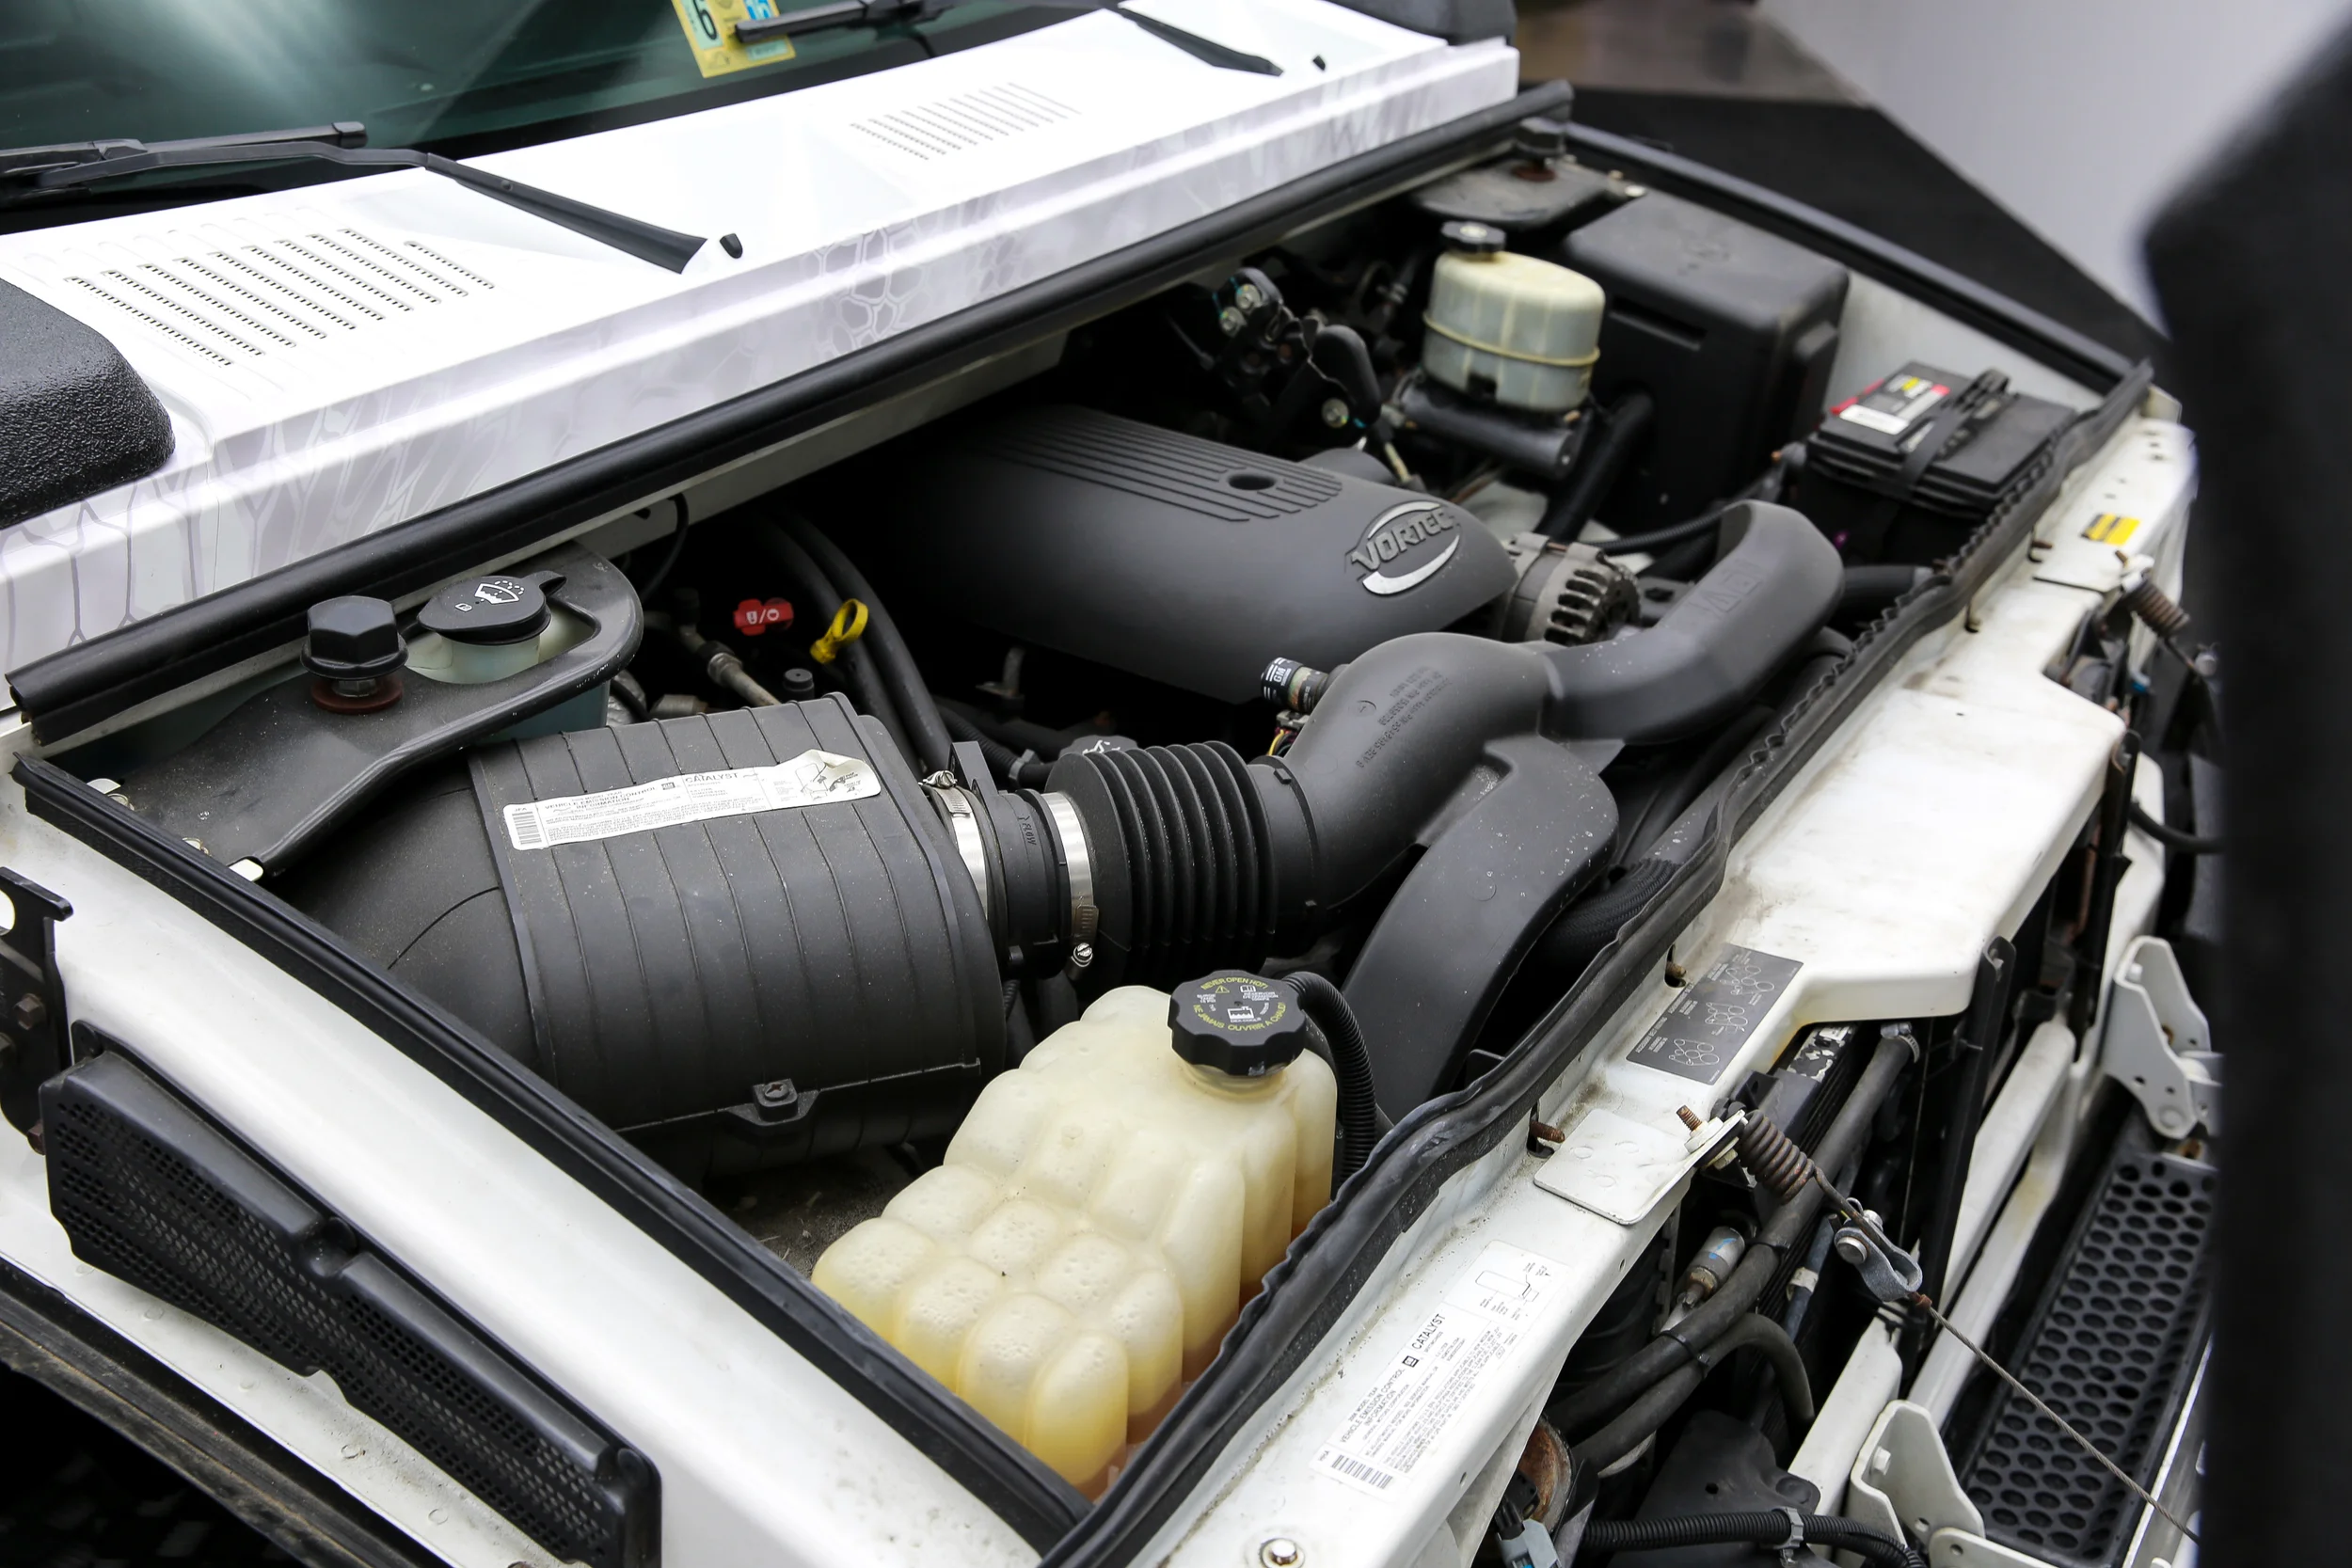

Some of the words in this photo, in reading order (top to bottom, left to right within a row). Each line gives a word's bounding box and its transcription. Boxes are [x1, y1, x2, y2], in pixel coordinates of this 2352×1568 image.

[1351, 507, 1454, 572] VORTEC
[1273, 667, 1286, 683] GM
[685, 772, 739, 784] CATALYST
[1200, 977, 1227, 990] NEVER
[1228, 1023, 1265, 1032] OUVRIR
[1410, 1313, 1446, 1350] CATALYST
[1340, 1418, 1362, 1443] VEHICLE
[1359, 1392, 1383, 1418] EMISSION
[1380, 1366, 1405, 1393] CONTROL
[1363, 1388, 1396, 1426] INFORMATION
